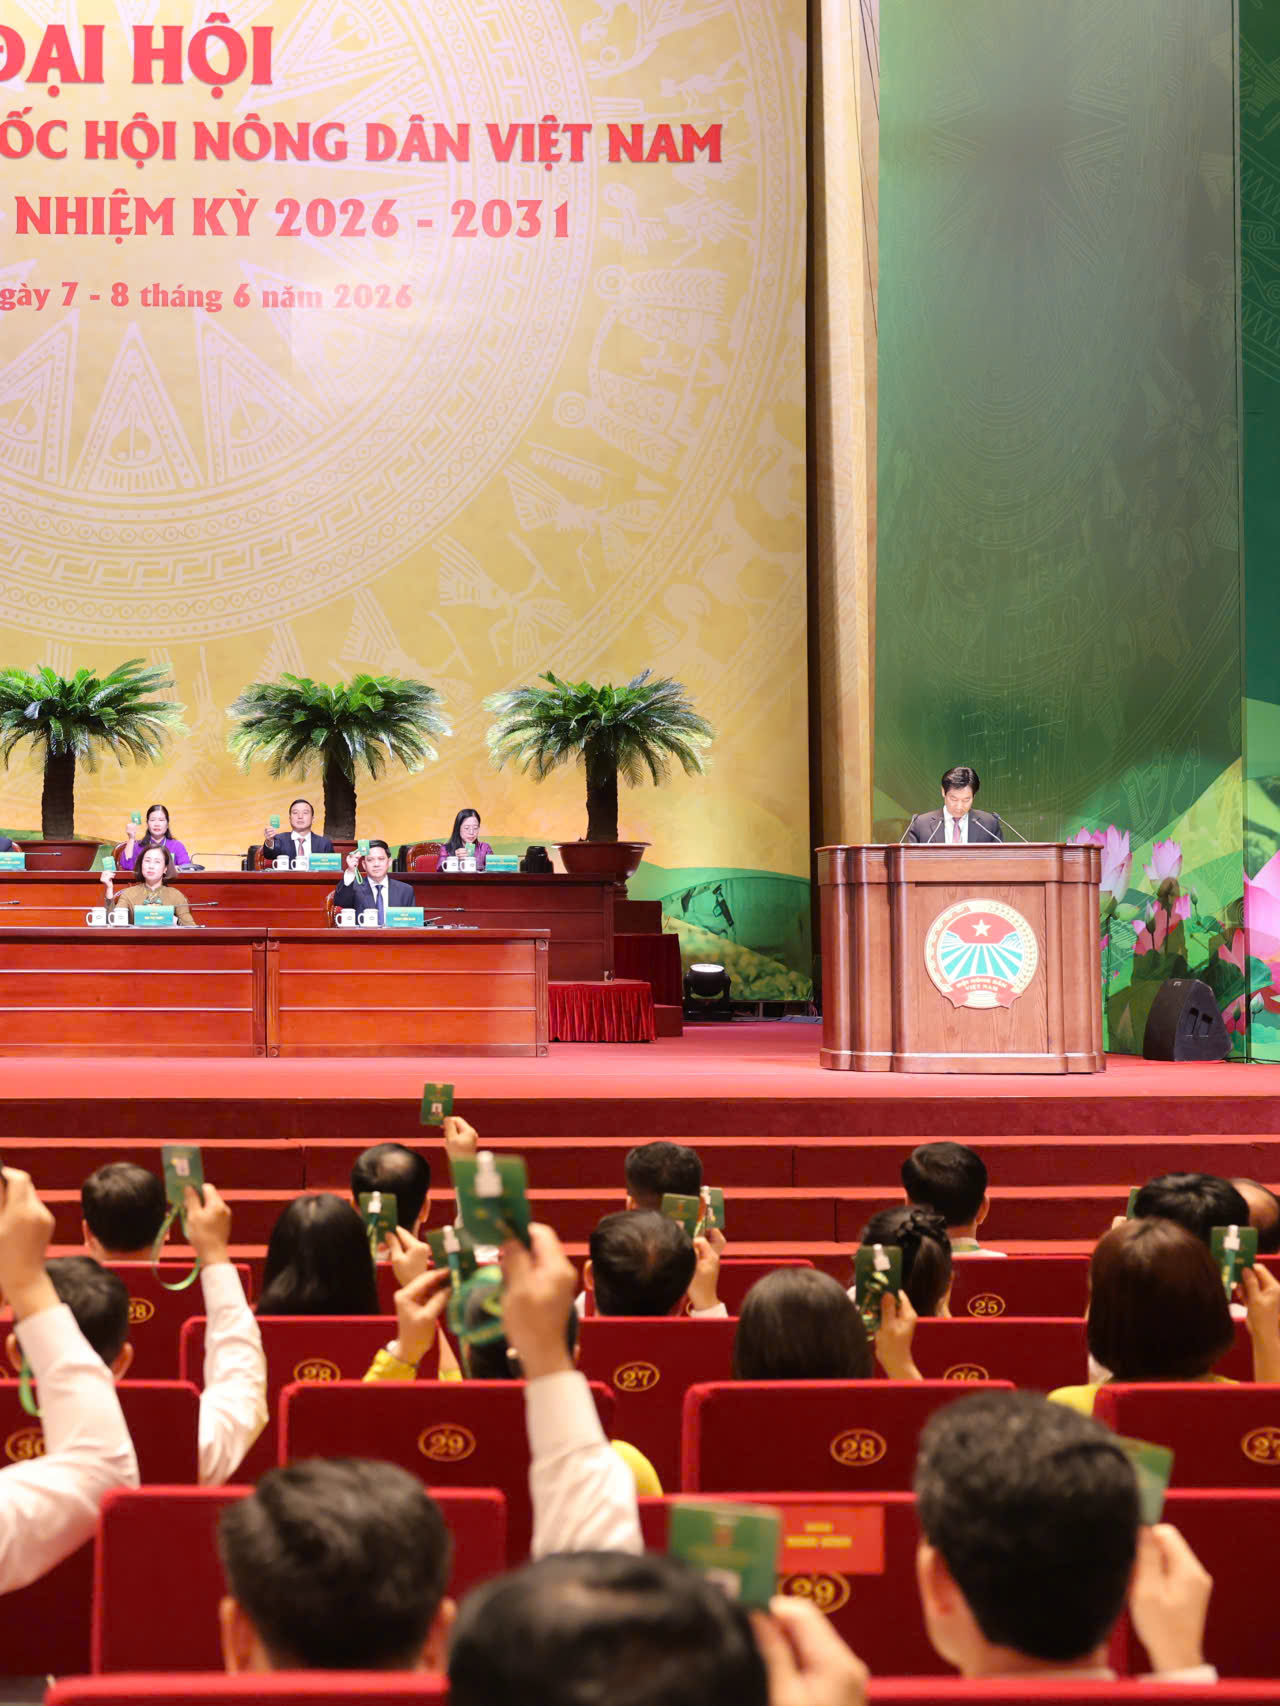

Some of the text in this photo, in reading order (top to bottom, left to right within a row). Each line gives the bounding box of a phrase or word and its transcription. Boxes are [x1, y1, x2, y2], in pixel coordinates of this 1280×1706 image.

[131, 12, 275, 100] HỘI
[84, 112, 177, 169] HỘI
[193, 113, 349, 161] NÔNG
[365, 114, 471, 163] DÂN
[486, 114, 593, 171] VIỆT
[607, 123, 723, 163] NAM
[15, 188, 176, 244] NHIỆM
[192, 189, 261, 237] KỲ
[275, 198, 399, 238] 2026
[451, 199, 570, 239] 2031
[61, 281, 79, 307] 7
[111, 281, 130, 308] 8
[140, 282, 223, 313] tháng
[233, 283, 251, 309] 6
[262, 284, 323, 310] năm
[334, 284, 414, 310] 2026
[975, 1300, 998, 1314] 25
[623, 1369, 652, 1387] 27
[431, 1434, 465, 1455] 29
[841, 1439, 875, 1459] 28
